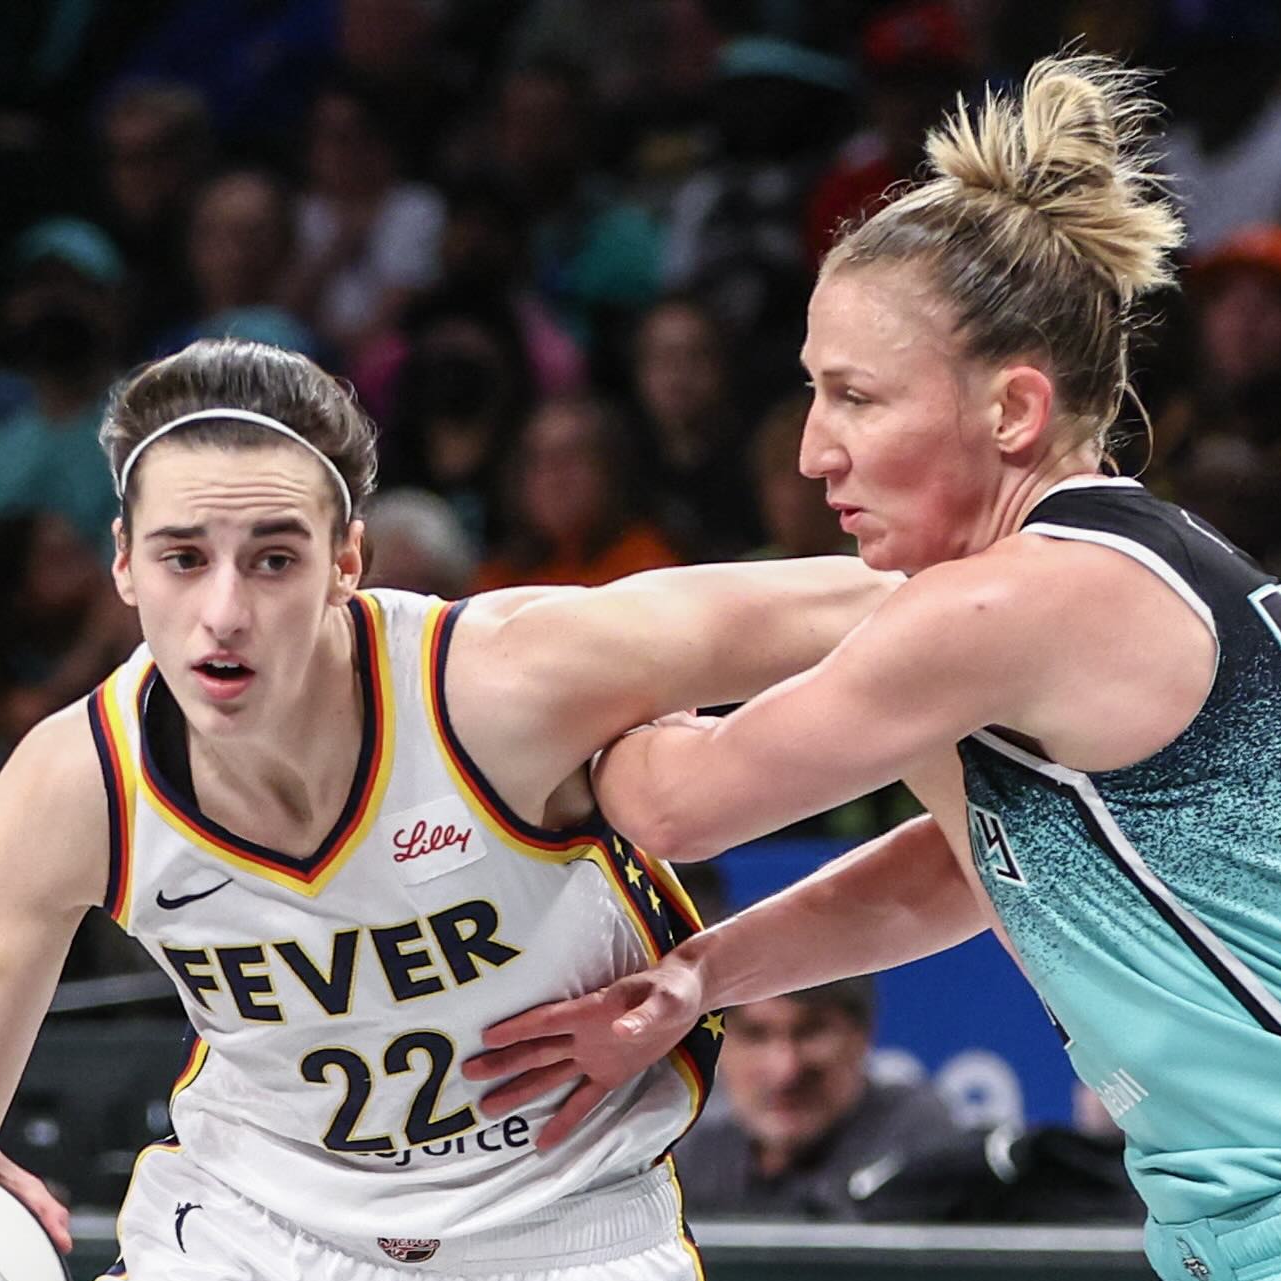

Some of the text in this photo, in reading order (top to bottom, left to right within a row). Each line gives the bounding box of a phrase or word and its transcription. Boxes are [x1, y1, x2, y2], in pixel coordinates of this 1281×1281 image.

[393, 820, 472, 863] Lilly
[159, 898, 526, 1026] FEVER
[299, 1028, 483, 1156] 22
